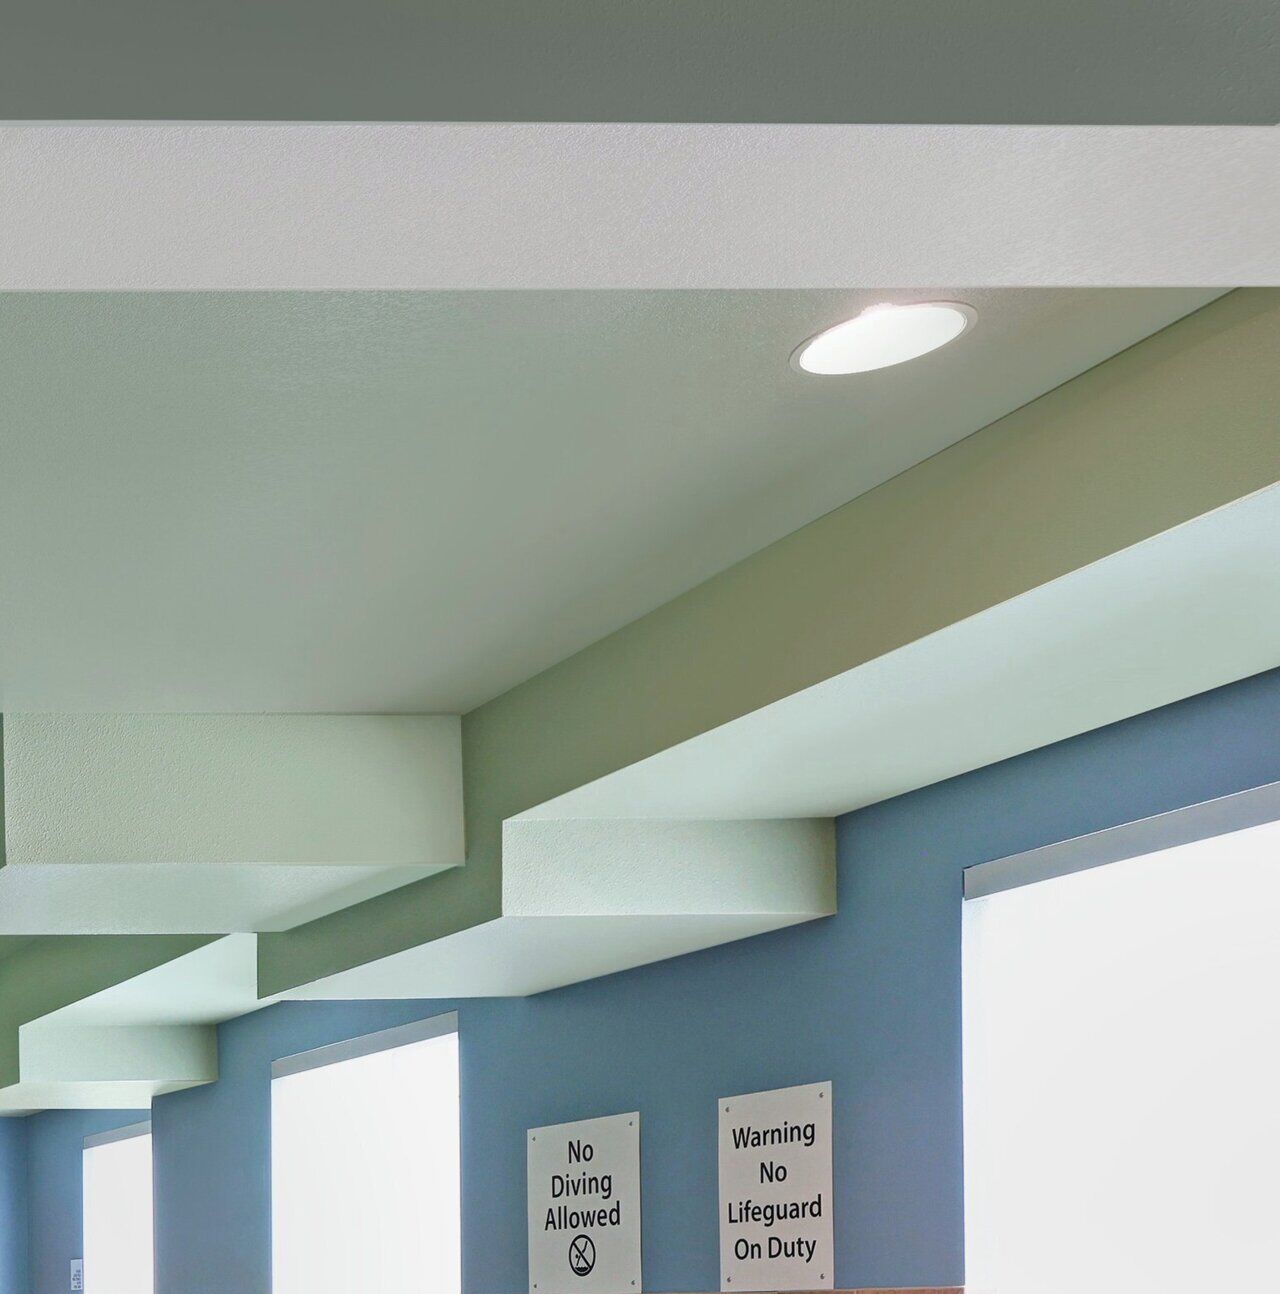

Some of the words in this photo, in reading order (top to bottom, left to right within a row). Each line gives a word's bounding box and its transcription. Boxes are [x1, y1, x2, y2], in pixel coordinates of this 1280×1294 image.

[732, 1121, 816, 1150] Warning
[568, 1140, 594, 1164] No
[551, 1171, 613, 1200] Diving
[759, 1161, 788, 1184] No
[544, 1200, 621, 1231] Allowed
[727, 1194, 822, 1227] Lifeguard
[734, 1238, 762, 1260] On
[768, 1236, 817, 1263] Duty
